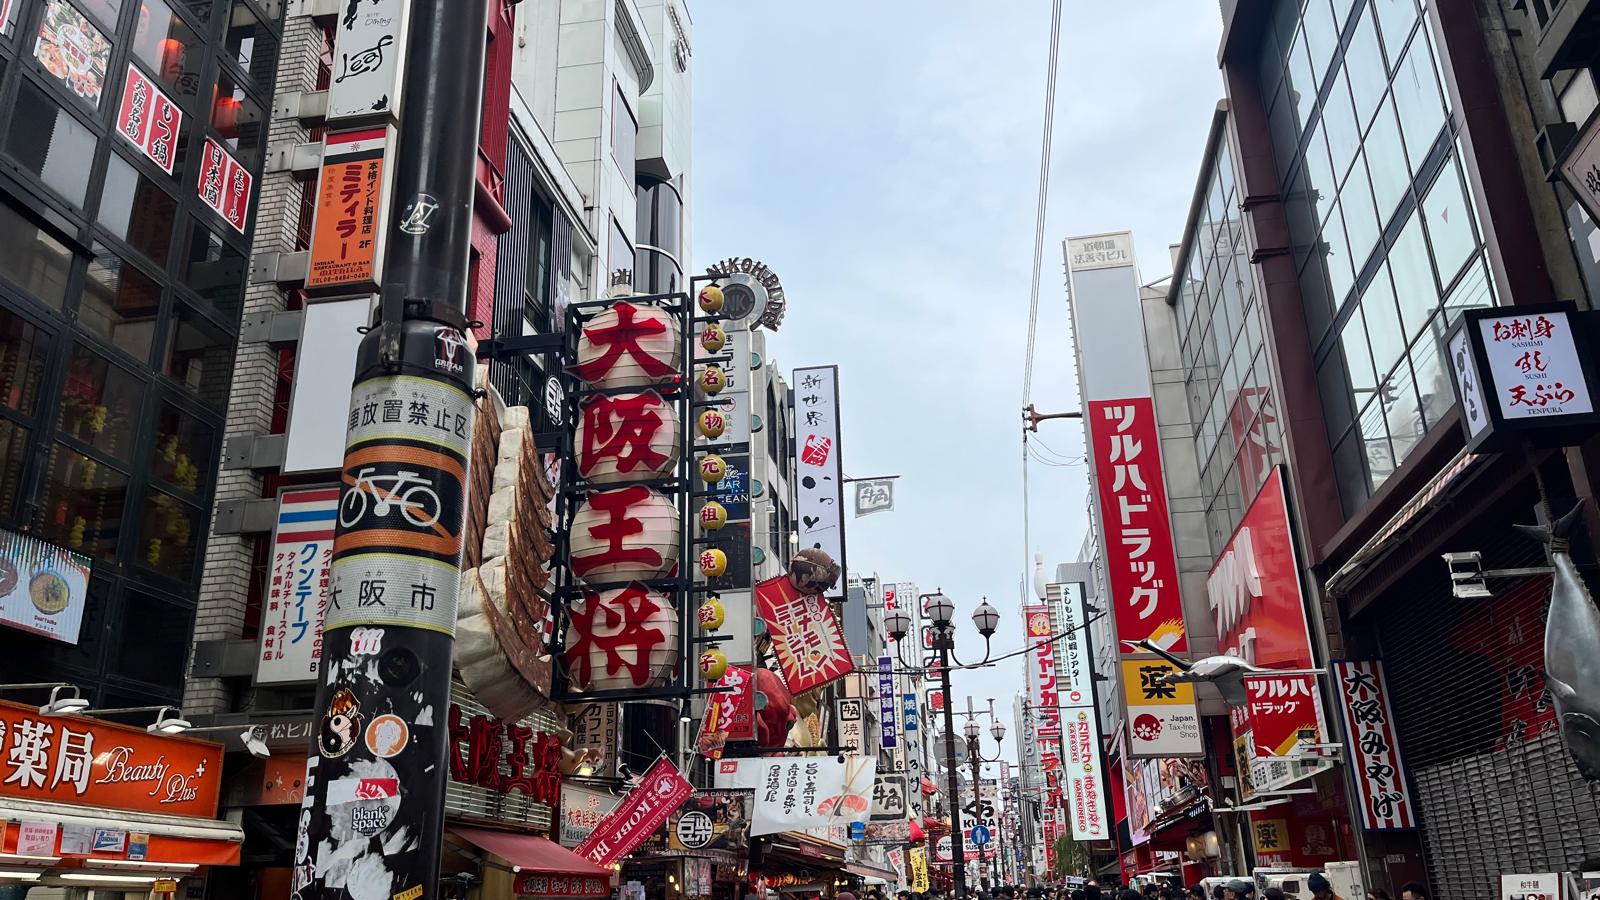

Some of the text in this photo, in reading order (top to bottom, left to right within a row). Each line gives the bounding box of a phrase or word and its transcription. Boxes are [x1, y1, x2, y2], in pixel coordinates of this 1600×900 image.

[335, 34, 394, 84] Leaf
[126, 79, 147, 139] 大阪名物
[150, 103, 175, 165] もつ鍋
[203, 145, 224, 207] 日本酒
[228, 170, 245, 222] 生ビール
[335, 165, 363, 260] ミティラー
[358, 161, 379, 249] 本格インド料理店 2F
[313, 262, 352, 271] RESTAURANT
[1492, 316, 1555, 342] お刺身
[1511, 340, 1544, 348] SASHIMI
[1514, 350, 1550, 374] すし
[1524, 372, 1547, 380] SUSHI
[1508, 382, 1575, 407] 天ぷら
[1527, 406, 1563, 415] TENPURA
[556, 300, 685, 690] 大阪王将
[716, 480, 740, 490] BAR
[861, 487, 889, 505] 牛角
[1104, 404, 1164, 620] ツルハドラッグ
[262, 552, 284, 661] タイ調味料 食材店
[275, 551, 296, 660] タイカルチャースクール
[291, 543, 318, 644] クンテープ
[311, 548, 333, 659] タイ料理とタイスキの店
[327, 579, 437, 614] 大阪市
[1140, 665, 1177, 699] 薬
[1248, 678, 1311, 698] ツルハ
[843, 704, 860, 717] 牛角
[904, 699, 917, 725] 焼肉
[1170, 714, 1196, 723] Japan.
[1251, 701, 1300, 715] ドラッグ
[605, 729, 614, 760] CAFE
[1069, 721, 1079, 764] KARAOKE
[1078, 721, 1092, 764] カラオケ
[1167, 723, 1197, 731] Tax-free
[1179, 731, 1198, 740] Shop
[1344, 670, 1405, 818] 大阪みやげ
[0, 719, 94, 794] 薬局
[95, 746, 170, 796] Beauty
[160, 773, 199, 803] Plus
[764, 764, 781, 803] 居酒屋
[906, 740, 922, 817] いろりや
[352, 805, 386, 821] blank
[873, 783, 903, 811] 牛角
[1075, 778, 1087, 833] MANEKINEKO
[1084, 775, 1101, 836] まねきねこ
[351, 818, 387, 832] space
[611, 799, 653, 845] KOBE
[1256, 822, 1279, 849] 薬
